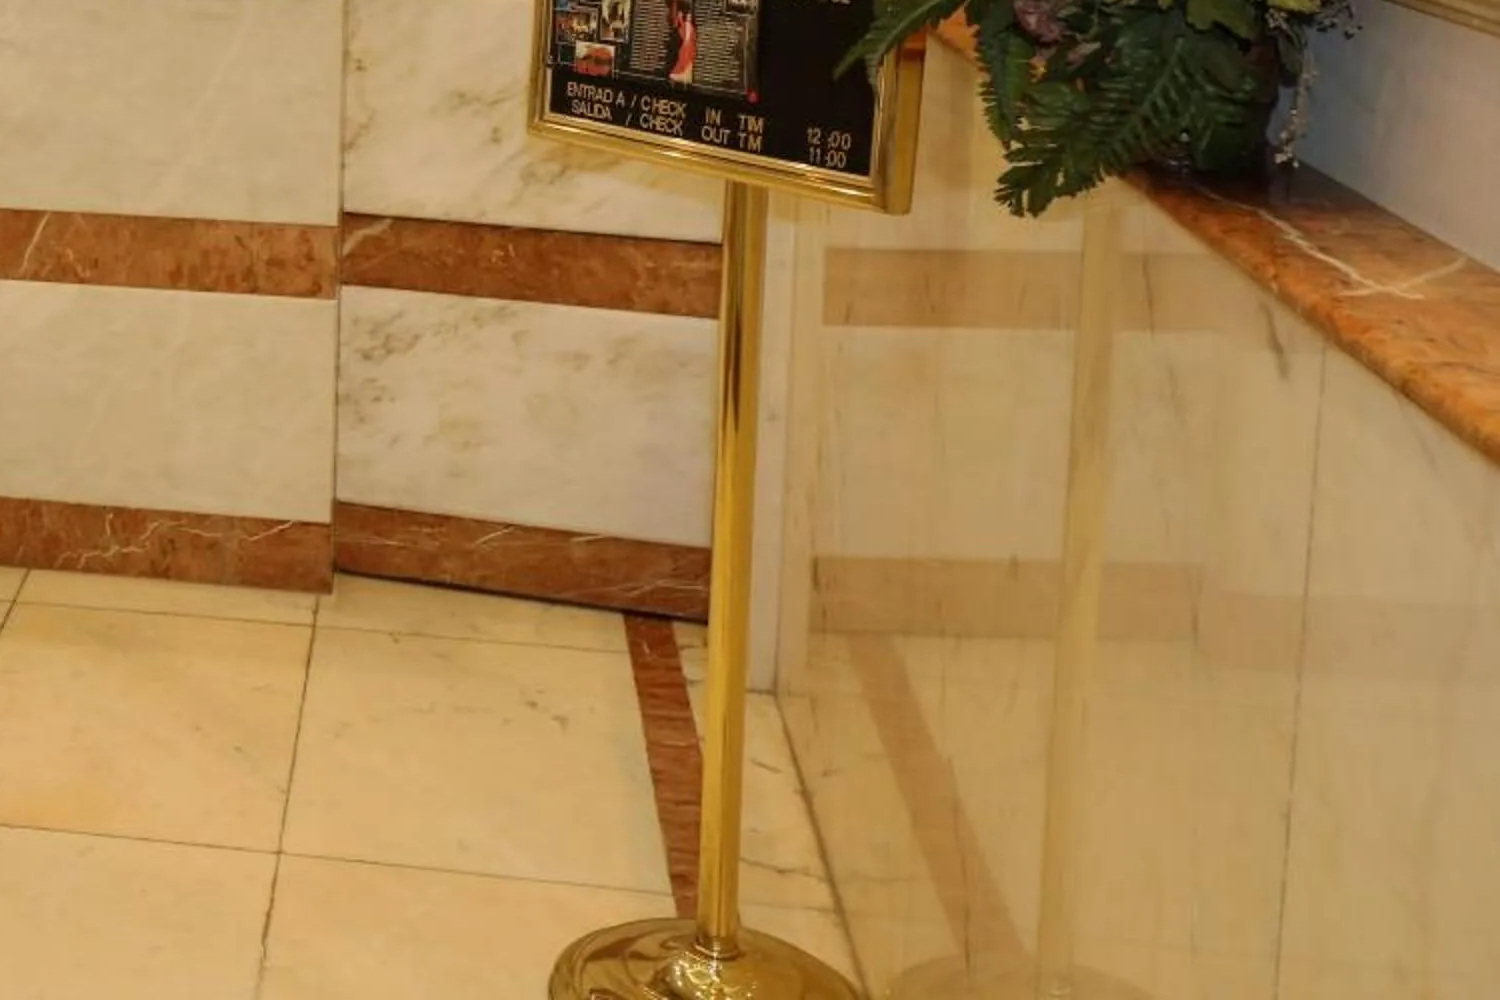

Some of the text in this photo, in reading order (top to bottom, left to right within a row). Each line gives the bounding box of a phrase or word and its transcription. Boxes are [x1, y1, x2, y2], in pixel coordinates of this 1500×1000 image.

[567, 81, 625, 109] ENTRADA
[641, 95, 687, 119] CHECK
[705, 108, 721, 126] IN
[640, 113, 683, 137] CHECK
[701, 125, 731, 145] OUT
